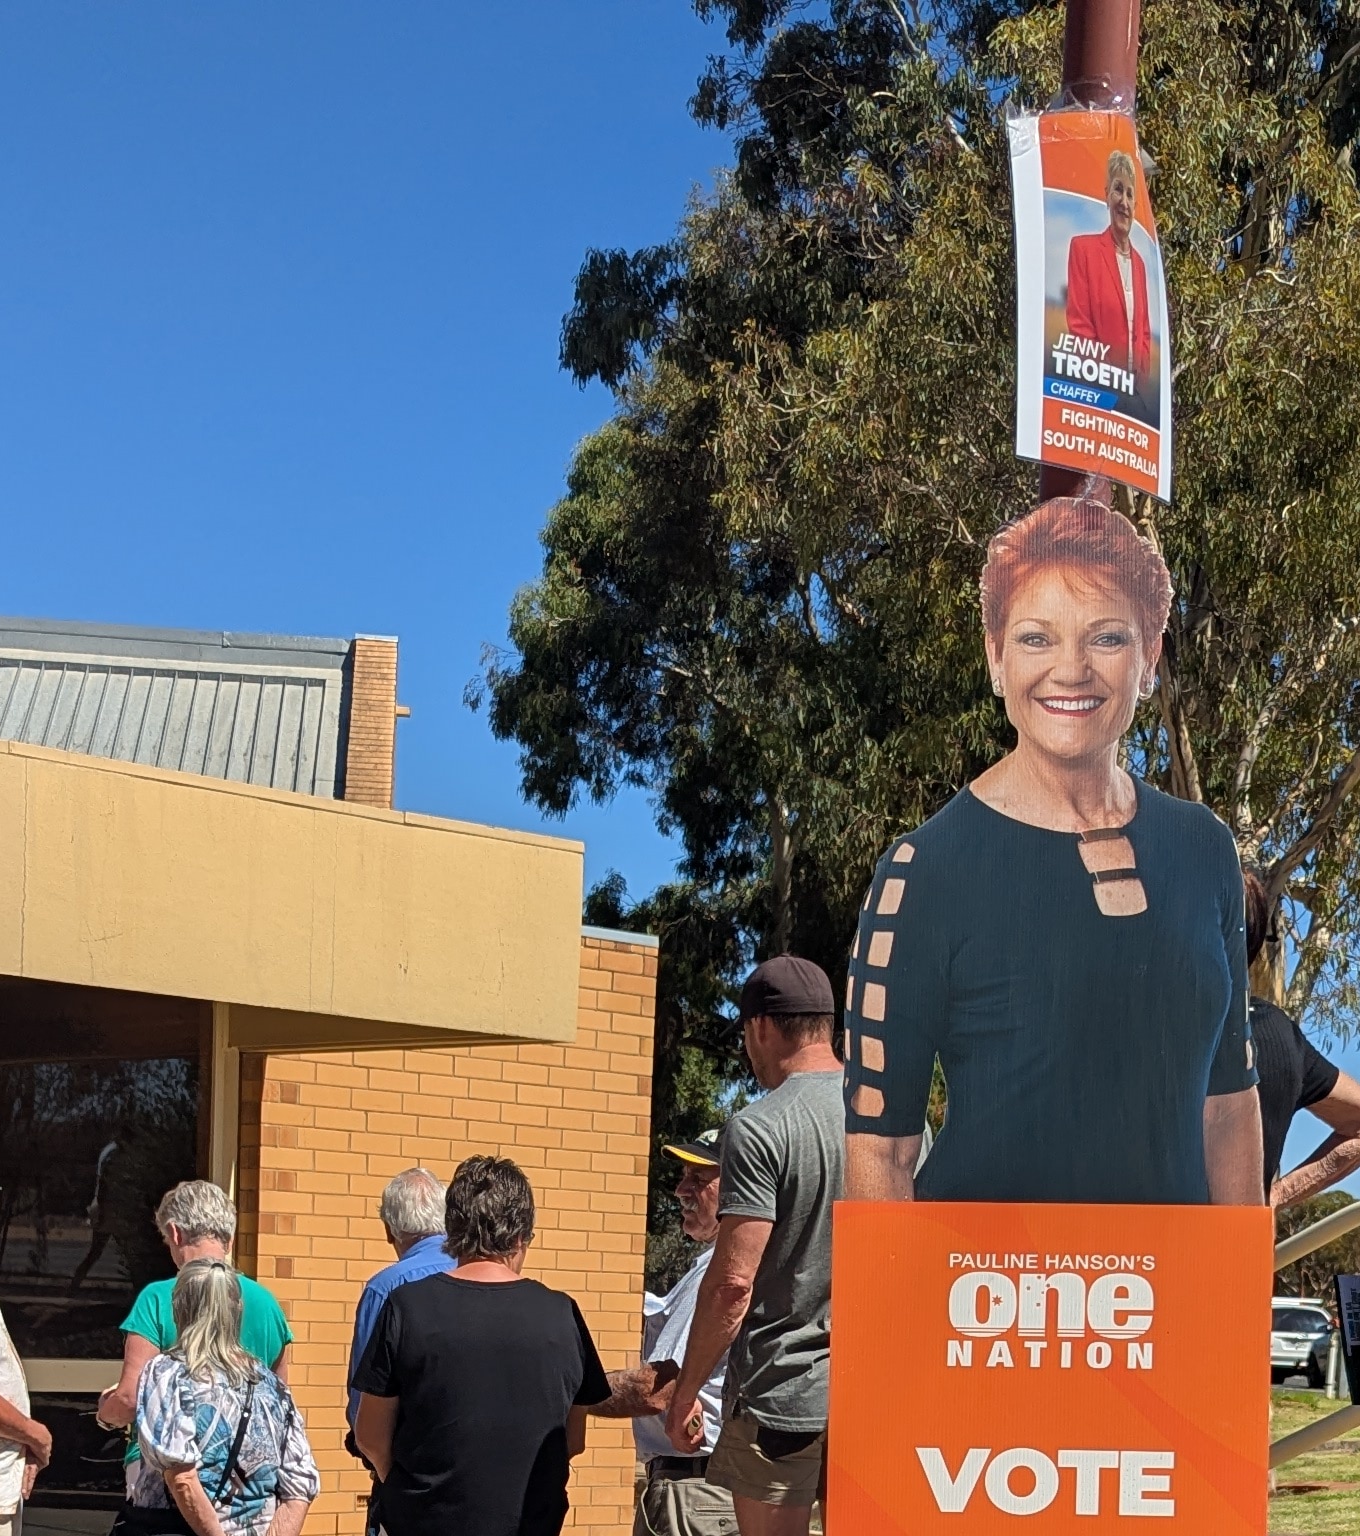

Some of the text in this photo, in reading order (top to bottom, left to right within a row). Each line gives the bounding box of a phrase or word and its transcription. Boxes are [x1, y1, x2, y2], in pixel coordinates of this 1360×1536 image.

[1053, 333, 1111, 360] JENNY
[1050, 382, 1101, 404] CHAFFEY
[1052, 351, 1135, 396] TROETH
[1062, 409, 1149, 451] FIGHTING FOR
[1044, 429, 1158, 479] SOUTH AUSTRALIA
[949, 1253, 1155, 1271] PAULINE HANSON'S
[948, 1273, 1154, 1338] one
[947, 1340, 1153, 1370] NATION
[915, 1447, 1175, 1516] VOTE
